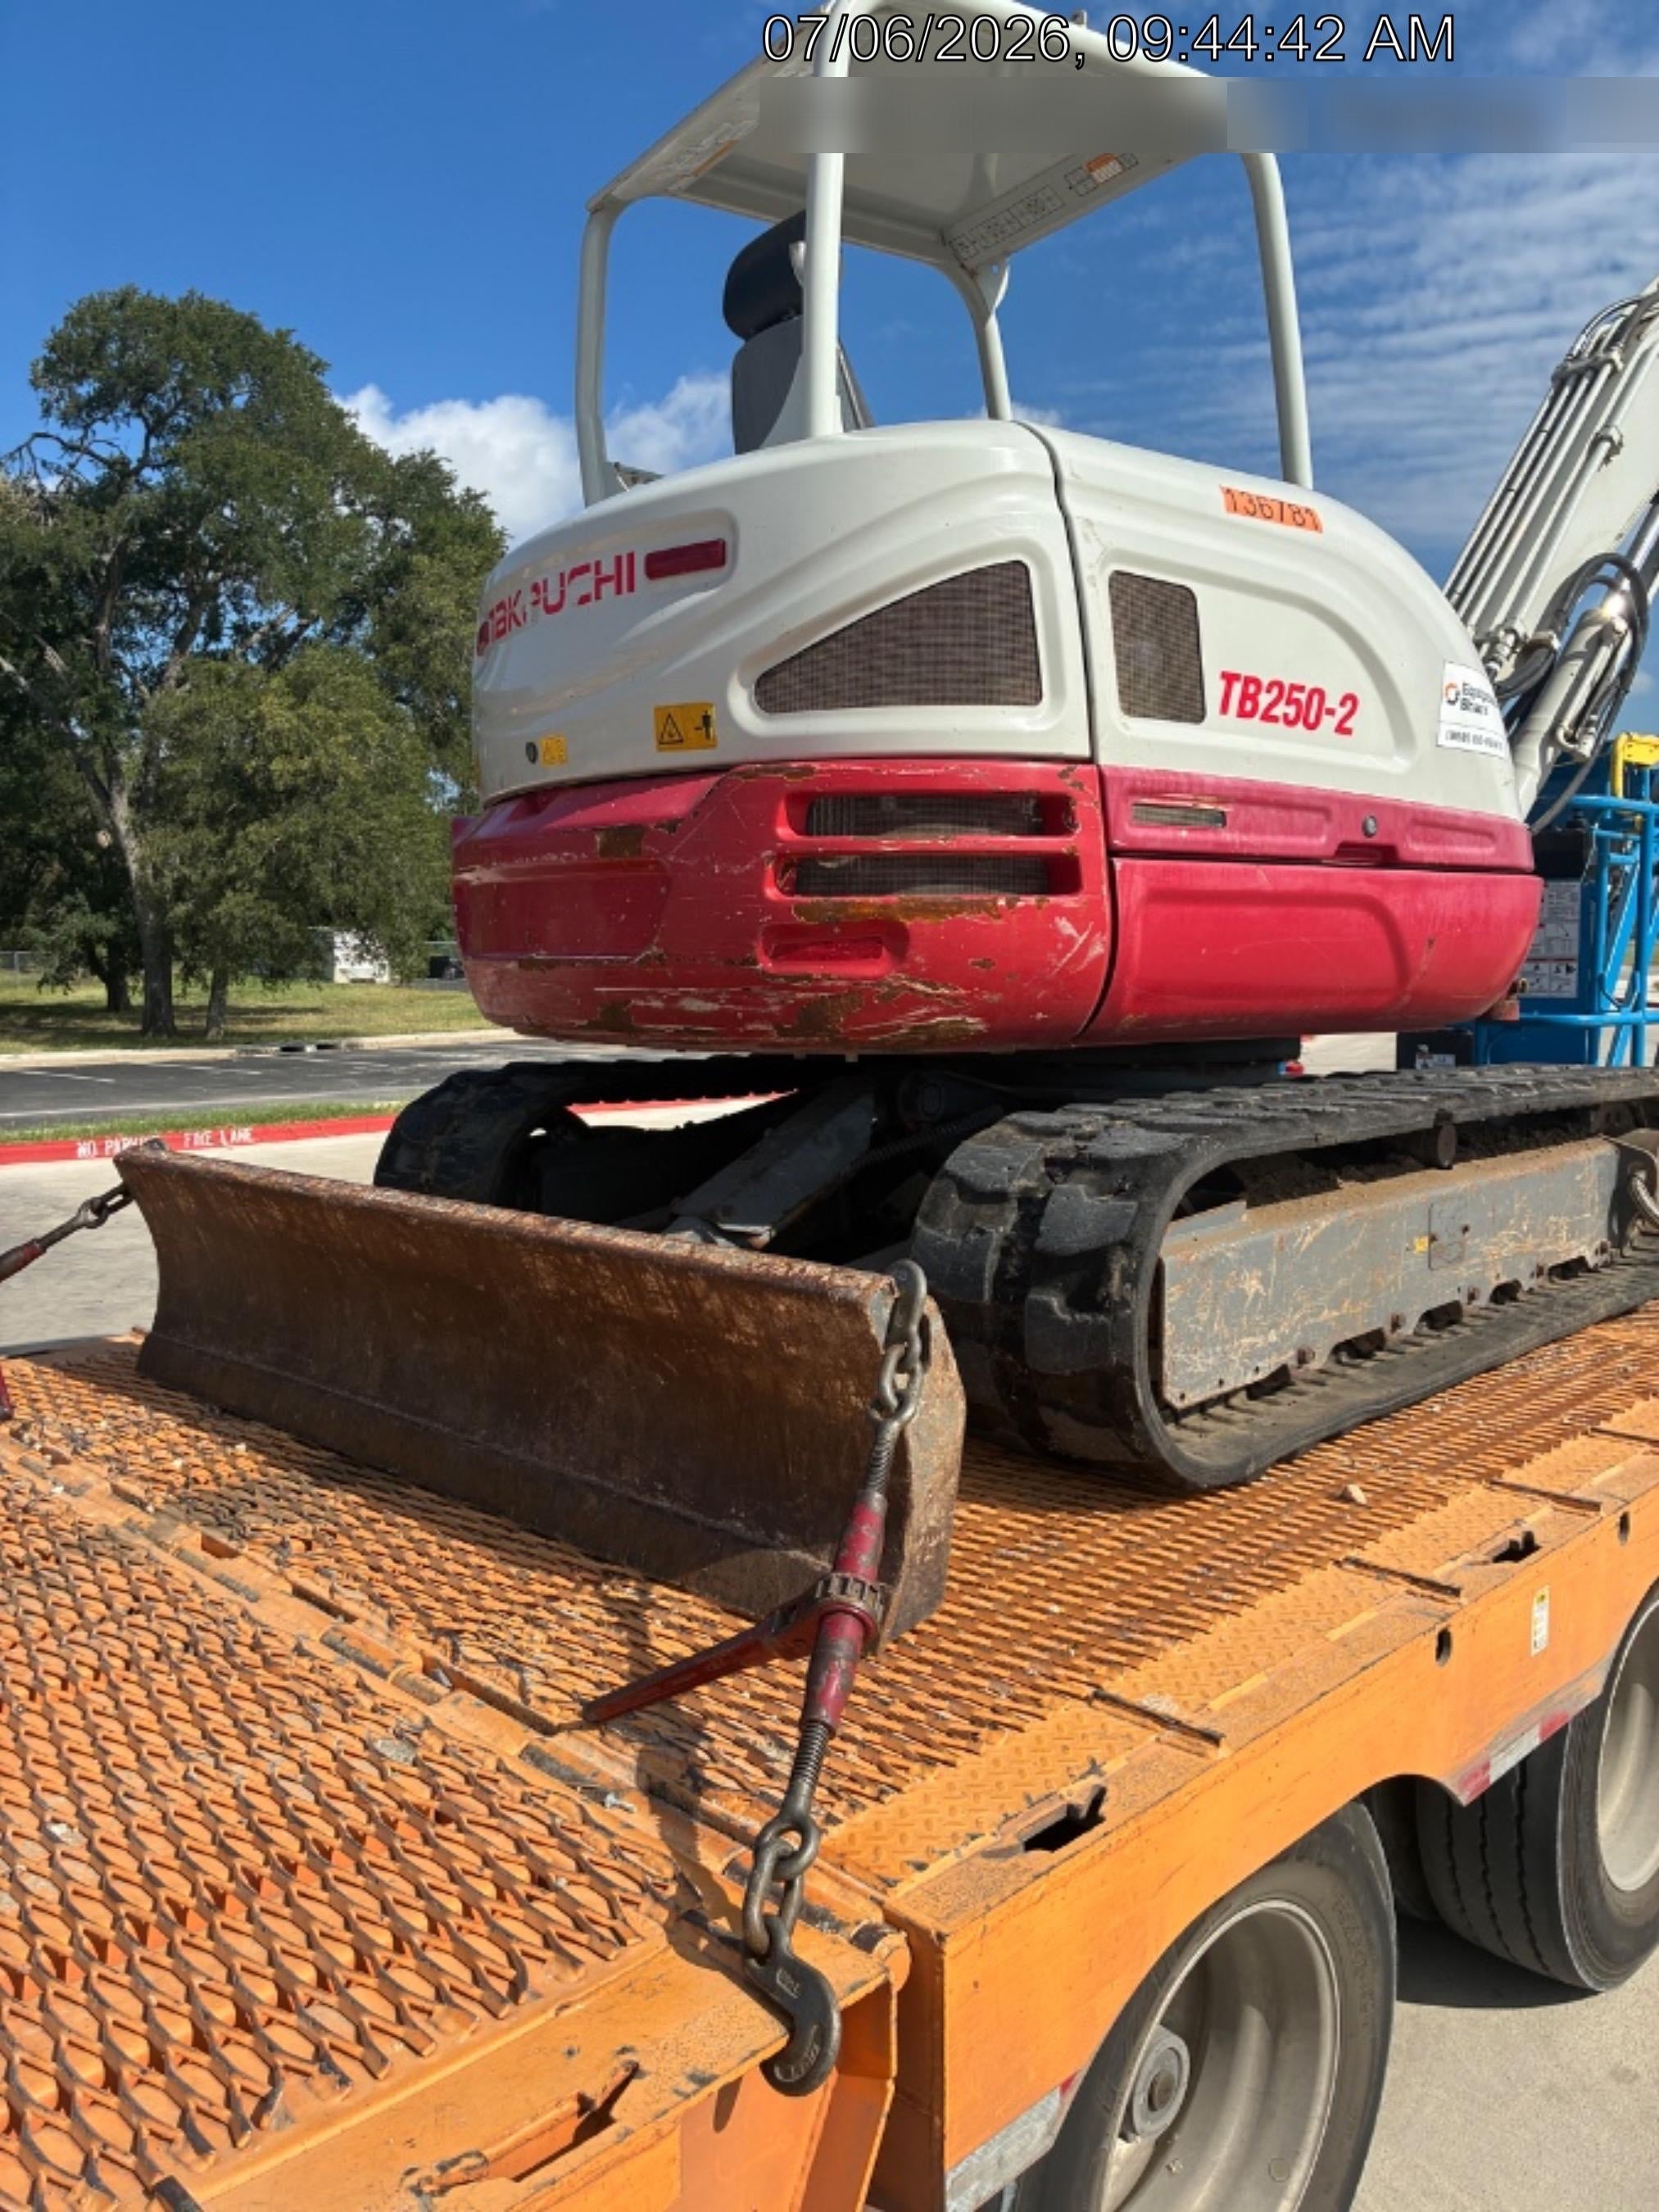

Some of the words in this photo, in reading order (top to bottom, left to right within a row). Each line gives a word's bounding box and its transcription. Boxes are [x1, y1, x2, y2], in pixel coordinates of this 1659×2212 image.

[1226, 488, 1319, 532] 136781
[1219, 670, 1358, 736] TB250-2
[77, 1139, 97, 1158] NO
